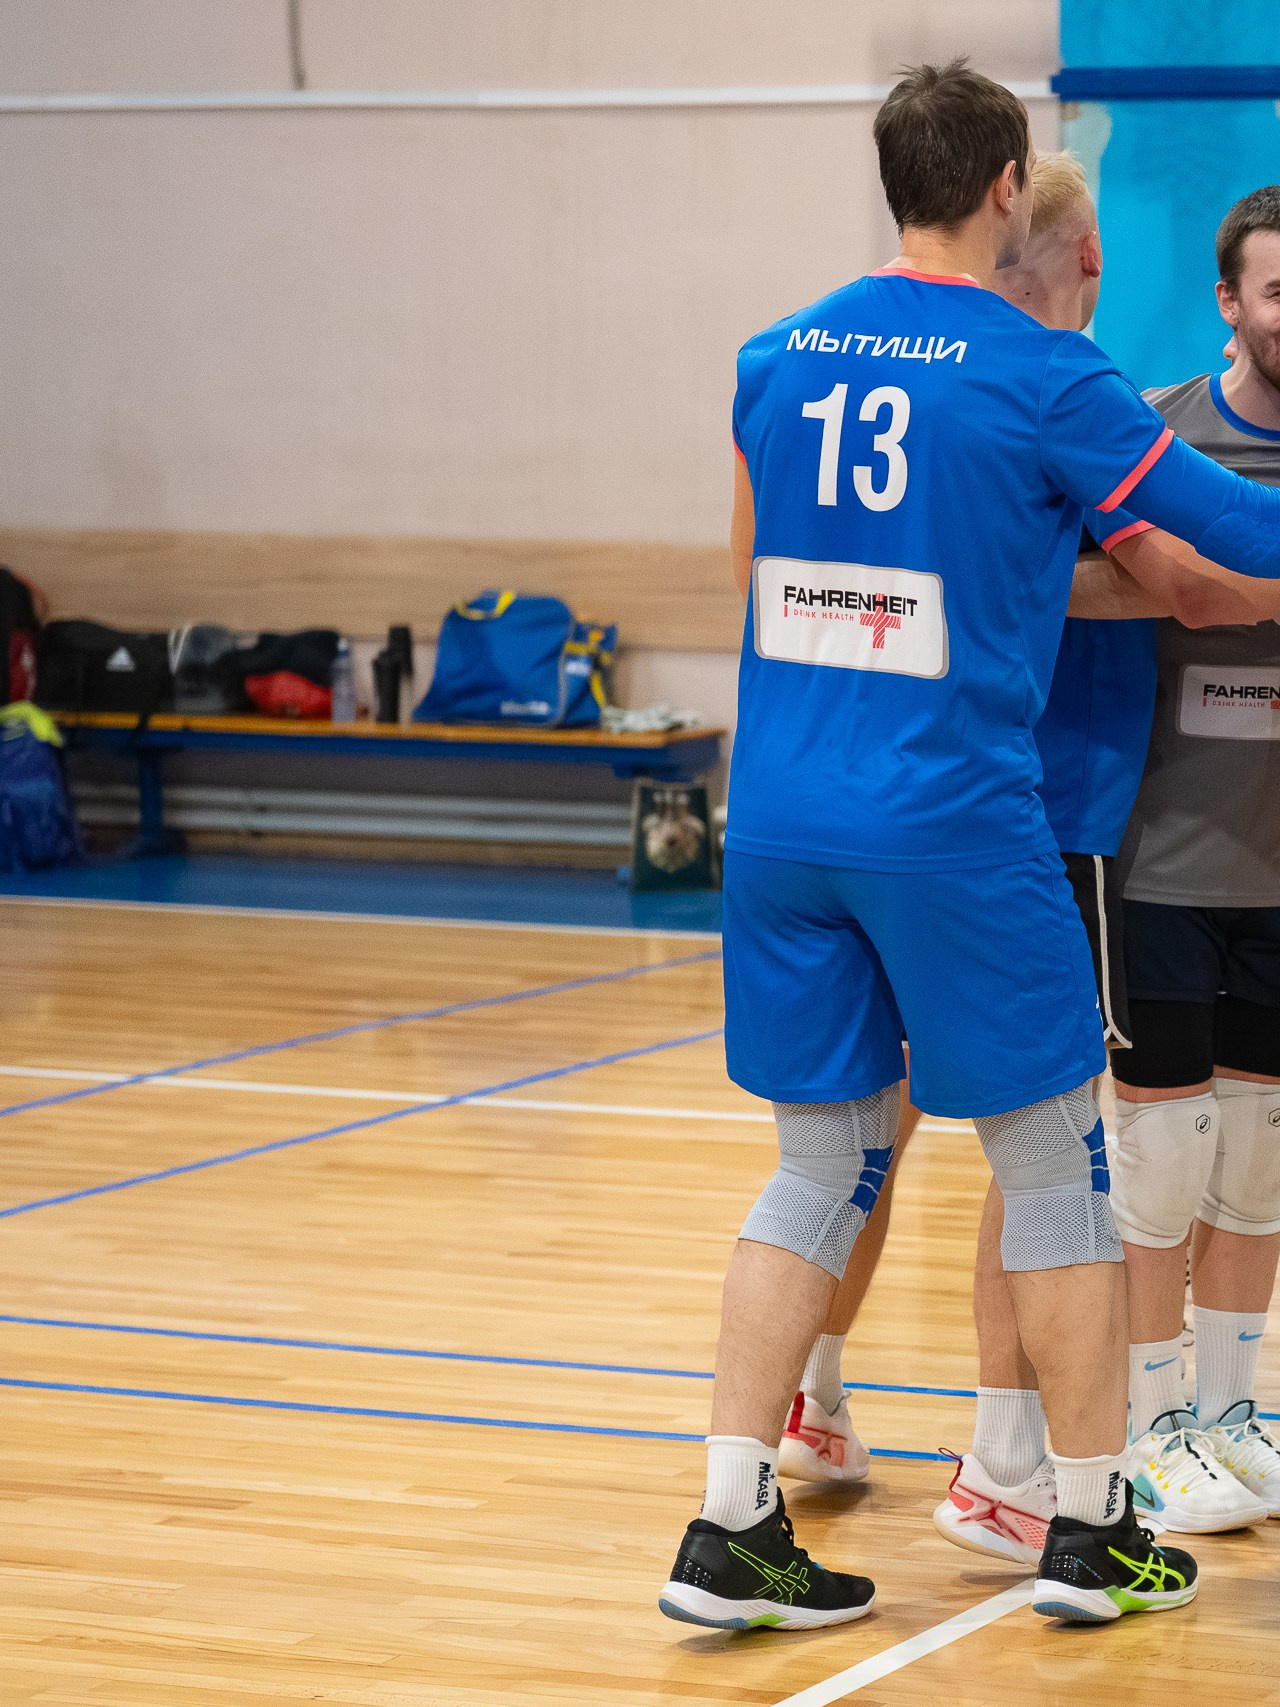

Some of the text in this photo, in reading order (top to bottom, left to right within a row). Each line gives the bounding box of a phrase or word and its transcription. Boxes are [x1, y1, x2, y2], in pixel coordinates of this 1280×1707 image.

[786, 328, 968, 364] МЫТИЩИ
[801, 382, 911, 512] 13
[784, 585, 918, 617] FAHRENHEIT
[821, 611, 855, 622] HEALTH
[754, 1461, 775, 1511] MIKASA
[1103, 1470, 1124, 1520] MIKASA
